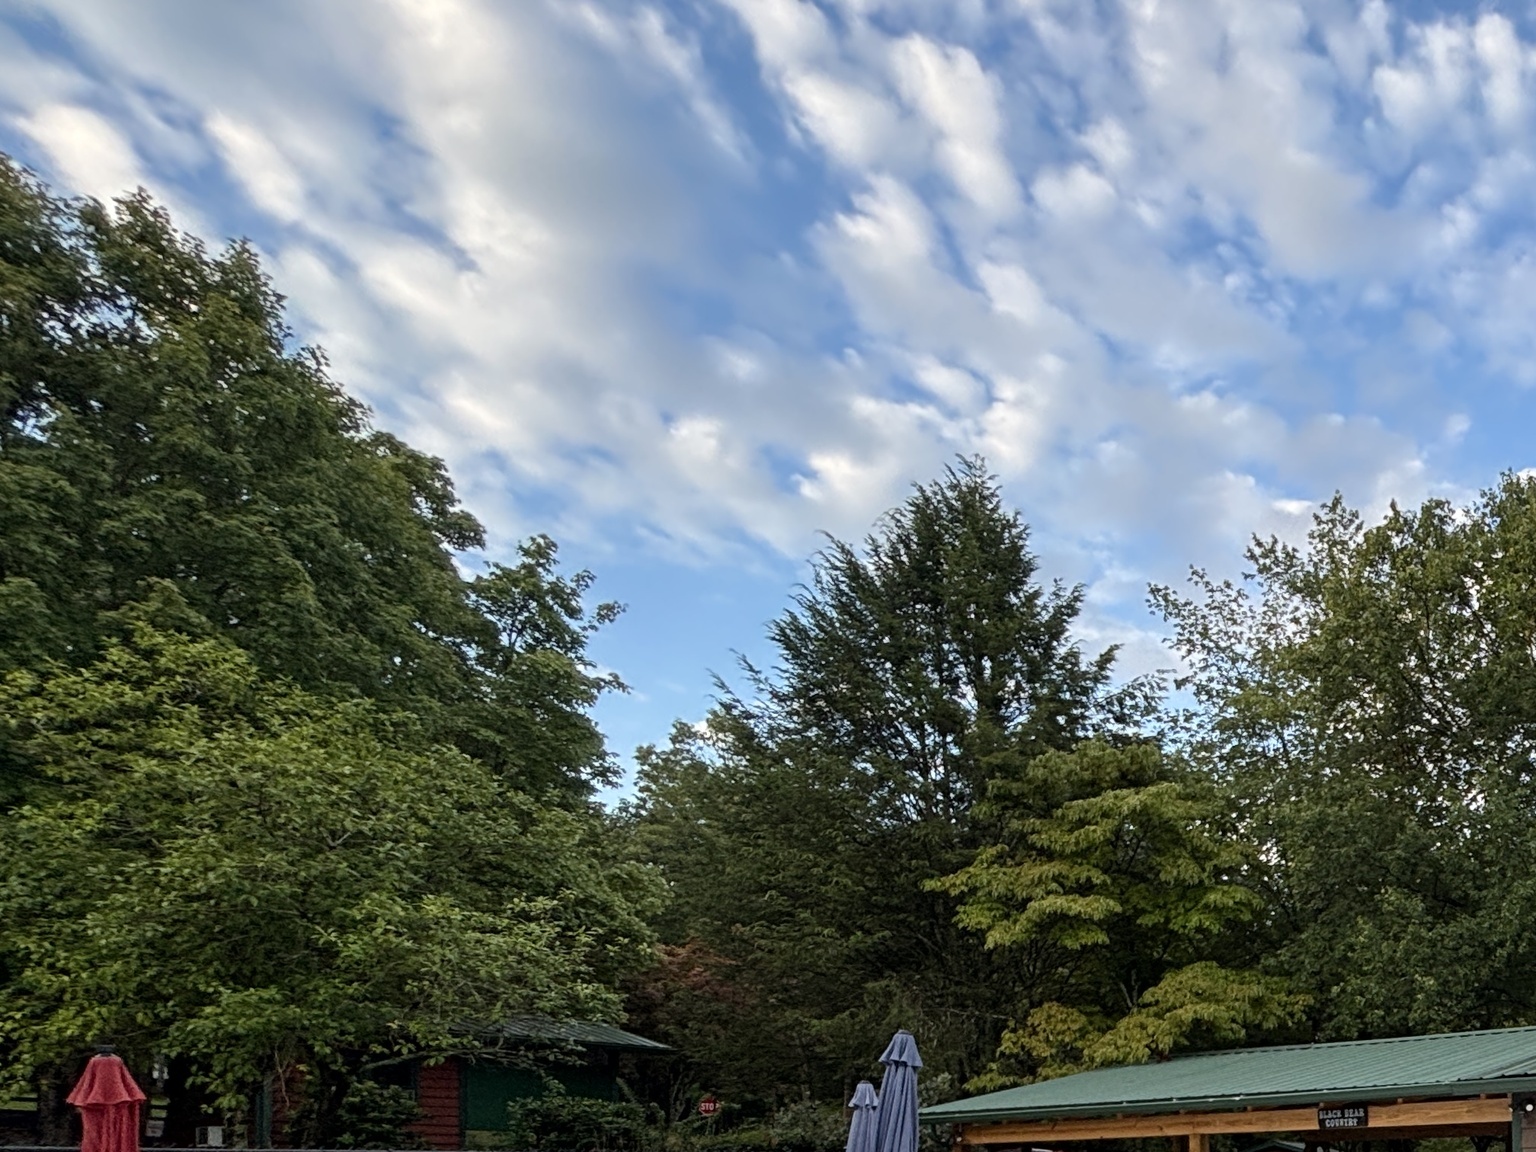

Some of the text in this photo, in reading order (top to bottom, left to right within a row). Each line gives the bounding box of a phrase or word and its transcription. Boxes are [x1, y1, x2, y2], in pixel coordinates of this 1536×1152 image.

[1319, 1108, 1364, 1119] BLACK BEAR
[1325, 1118, 1358, 1128] COUNTRY
